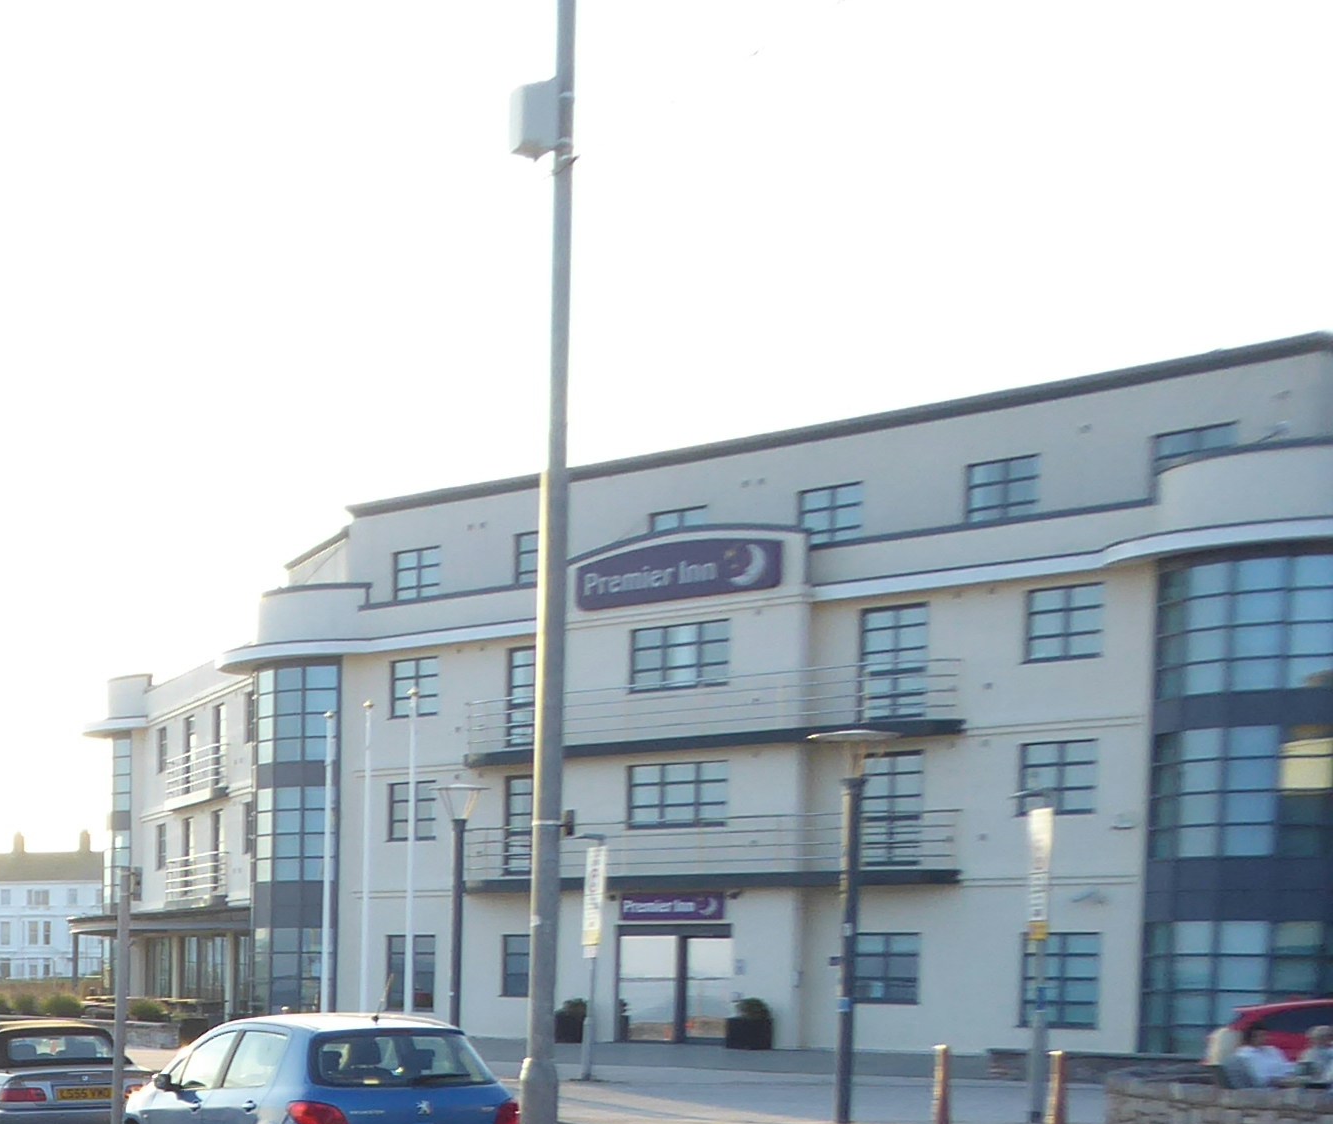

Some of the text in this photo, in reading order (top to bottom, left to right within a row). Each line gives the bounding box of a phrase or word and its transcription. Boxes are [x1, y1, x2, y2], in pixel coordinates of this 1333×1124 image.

[584, 560, 719, 596] Premier Inn
[622, 899, 696, 913] Premier Inn
